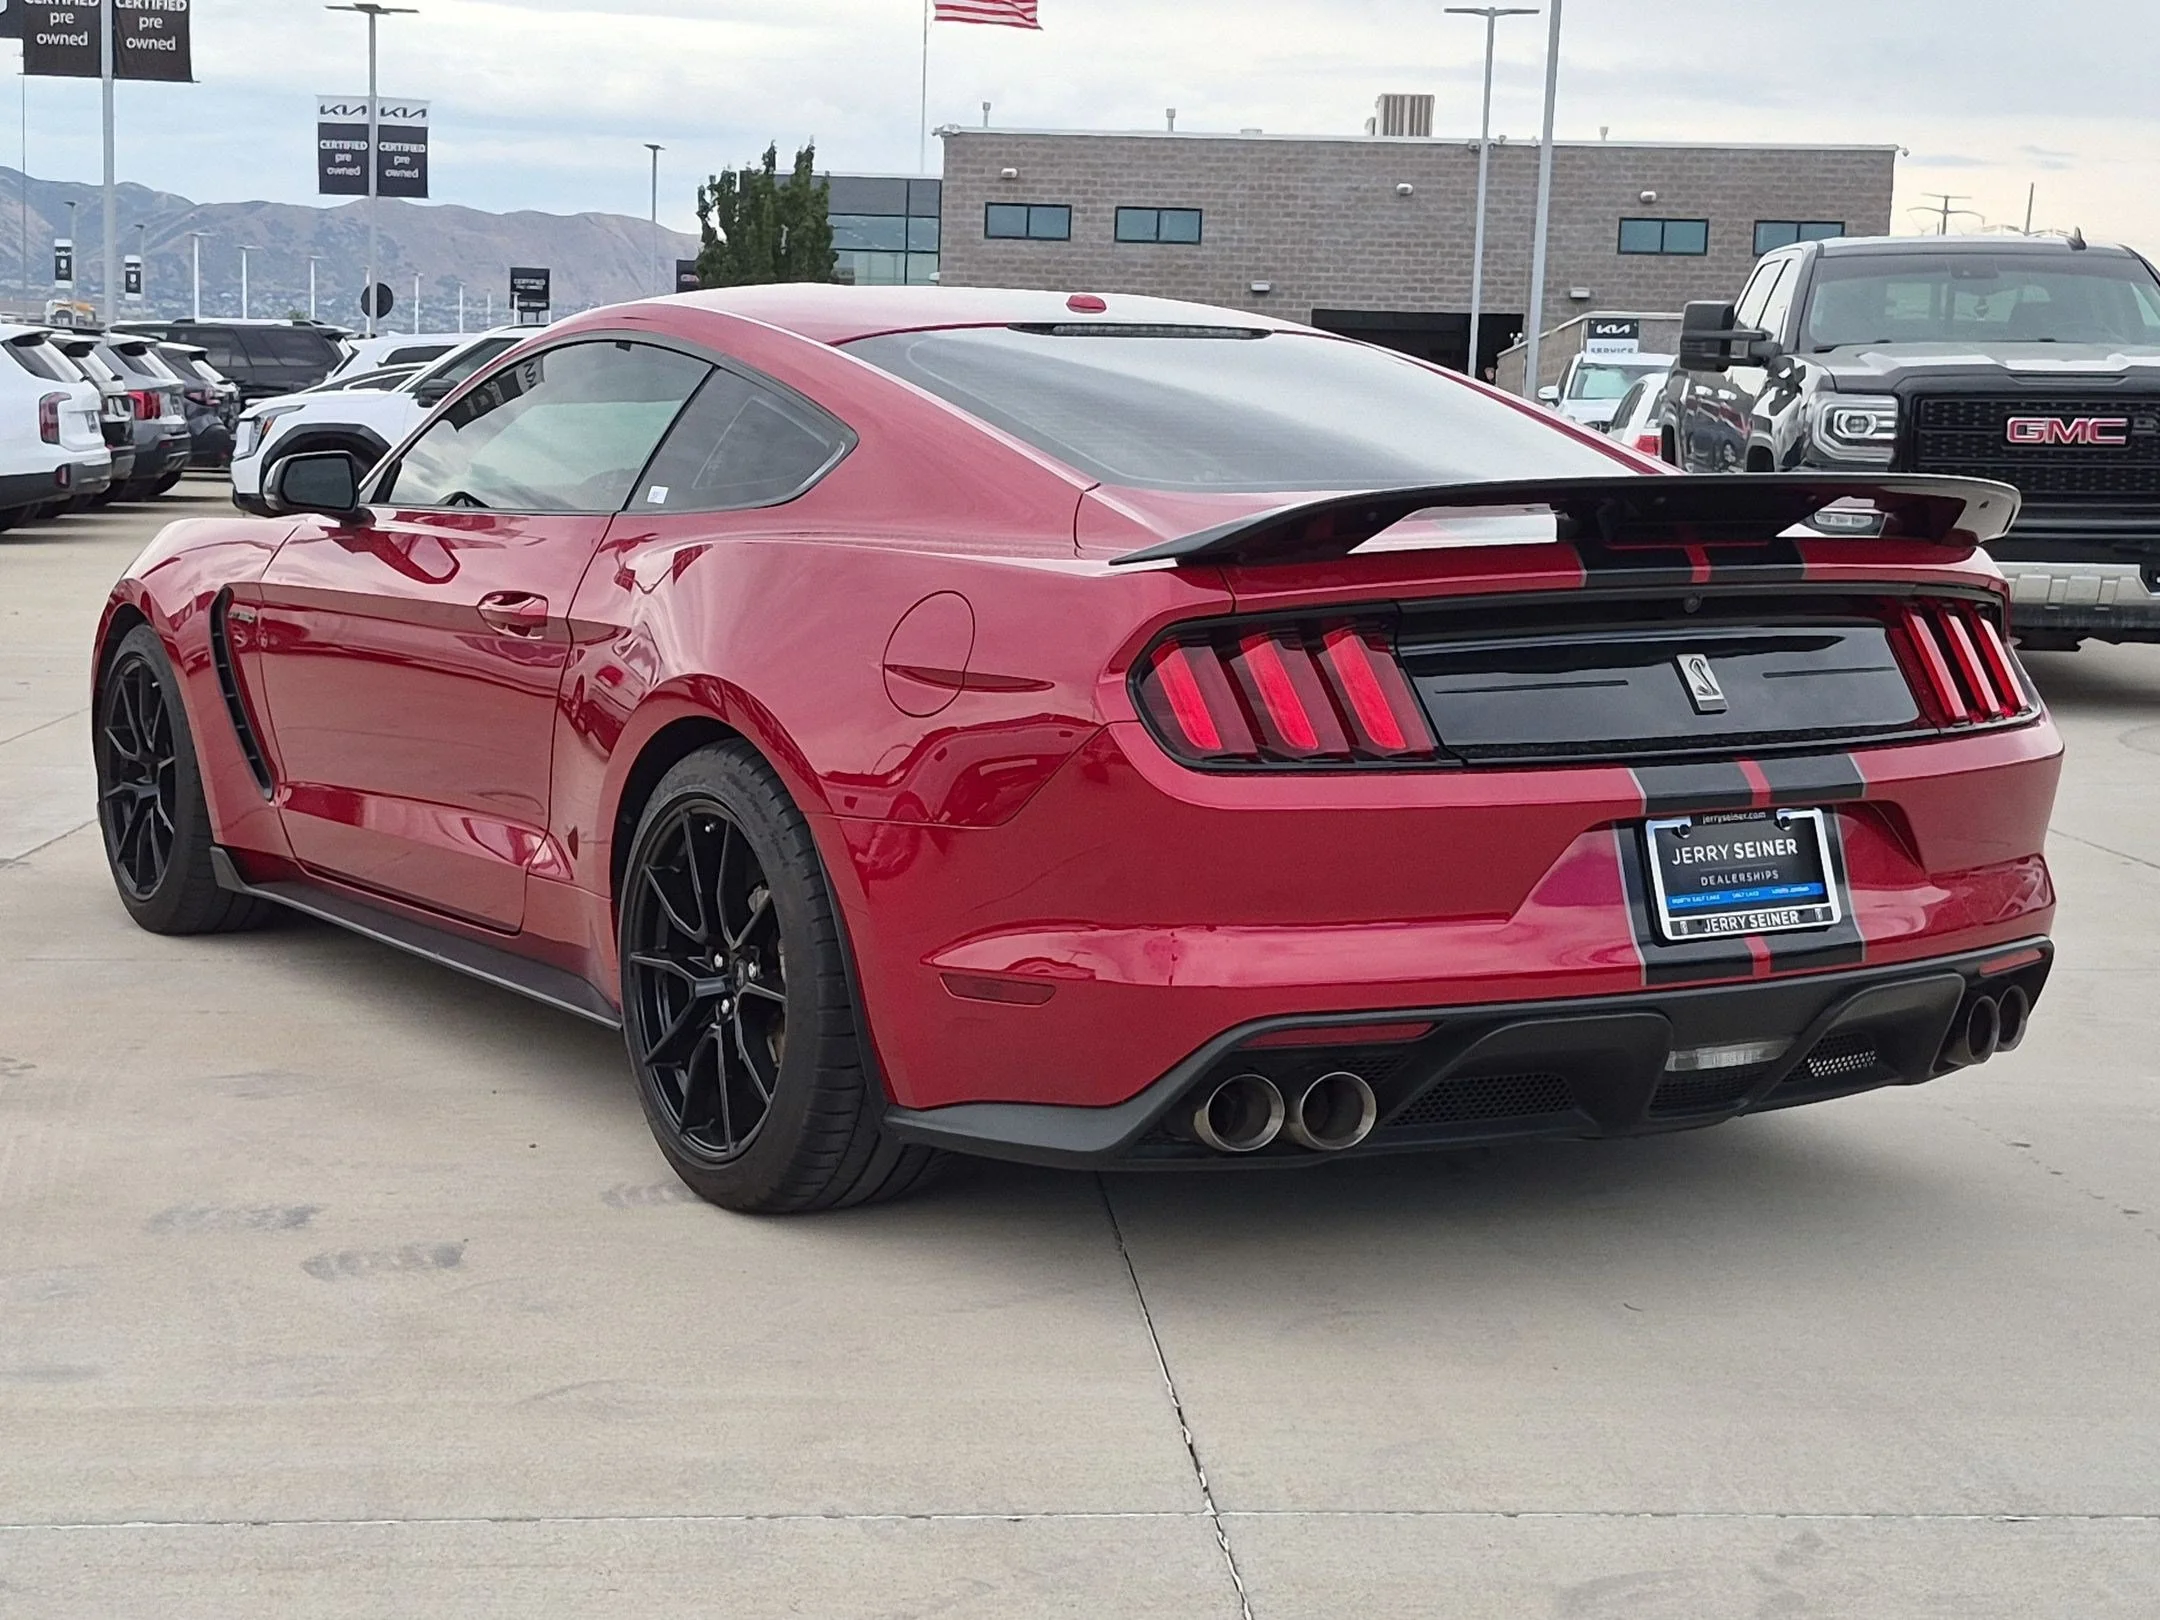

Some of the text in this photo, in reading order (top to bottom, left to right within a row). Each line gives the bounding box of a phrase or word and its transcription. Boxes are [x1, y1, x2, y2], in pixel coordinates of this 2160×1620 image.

[115, 0, 187, 12] CERTIFIED
[50, 12, 75, 26] pre
[139, 16, 163, 31] pre
[36, 31, 88, 46] owned
[126, 36, 176, 51] owned
[320, 104, 367, 115] KIA
[380, 106, 427, 118] KIA
[320, 140, 368, 151] CERTIFIED
[379, 141, 426, 153] CERTIFIED
[335, 153, 352, 163] pre
[394, 155, 411, 165] pre
[326, 166, 361, 176] owned
[385, 168, 419, 178] owned
[1596, 324, 1630, 334] KIA
[2007, 417, 2128, 445] GMC
[1702, 811, 1766, 825] jerryseiner.com
[1671, 838, 1799, 866] JERRY SEINER
[1700, 869, 1780, 887] DEALERSHIPS
[1704, 911, 1800, 933] JERRY SEINER
